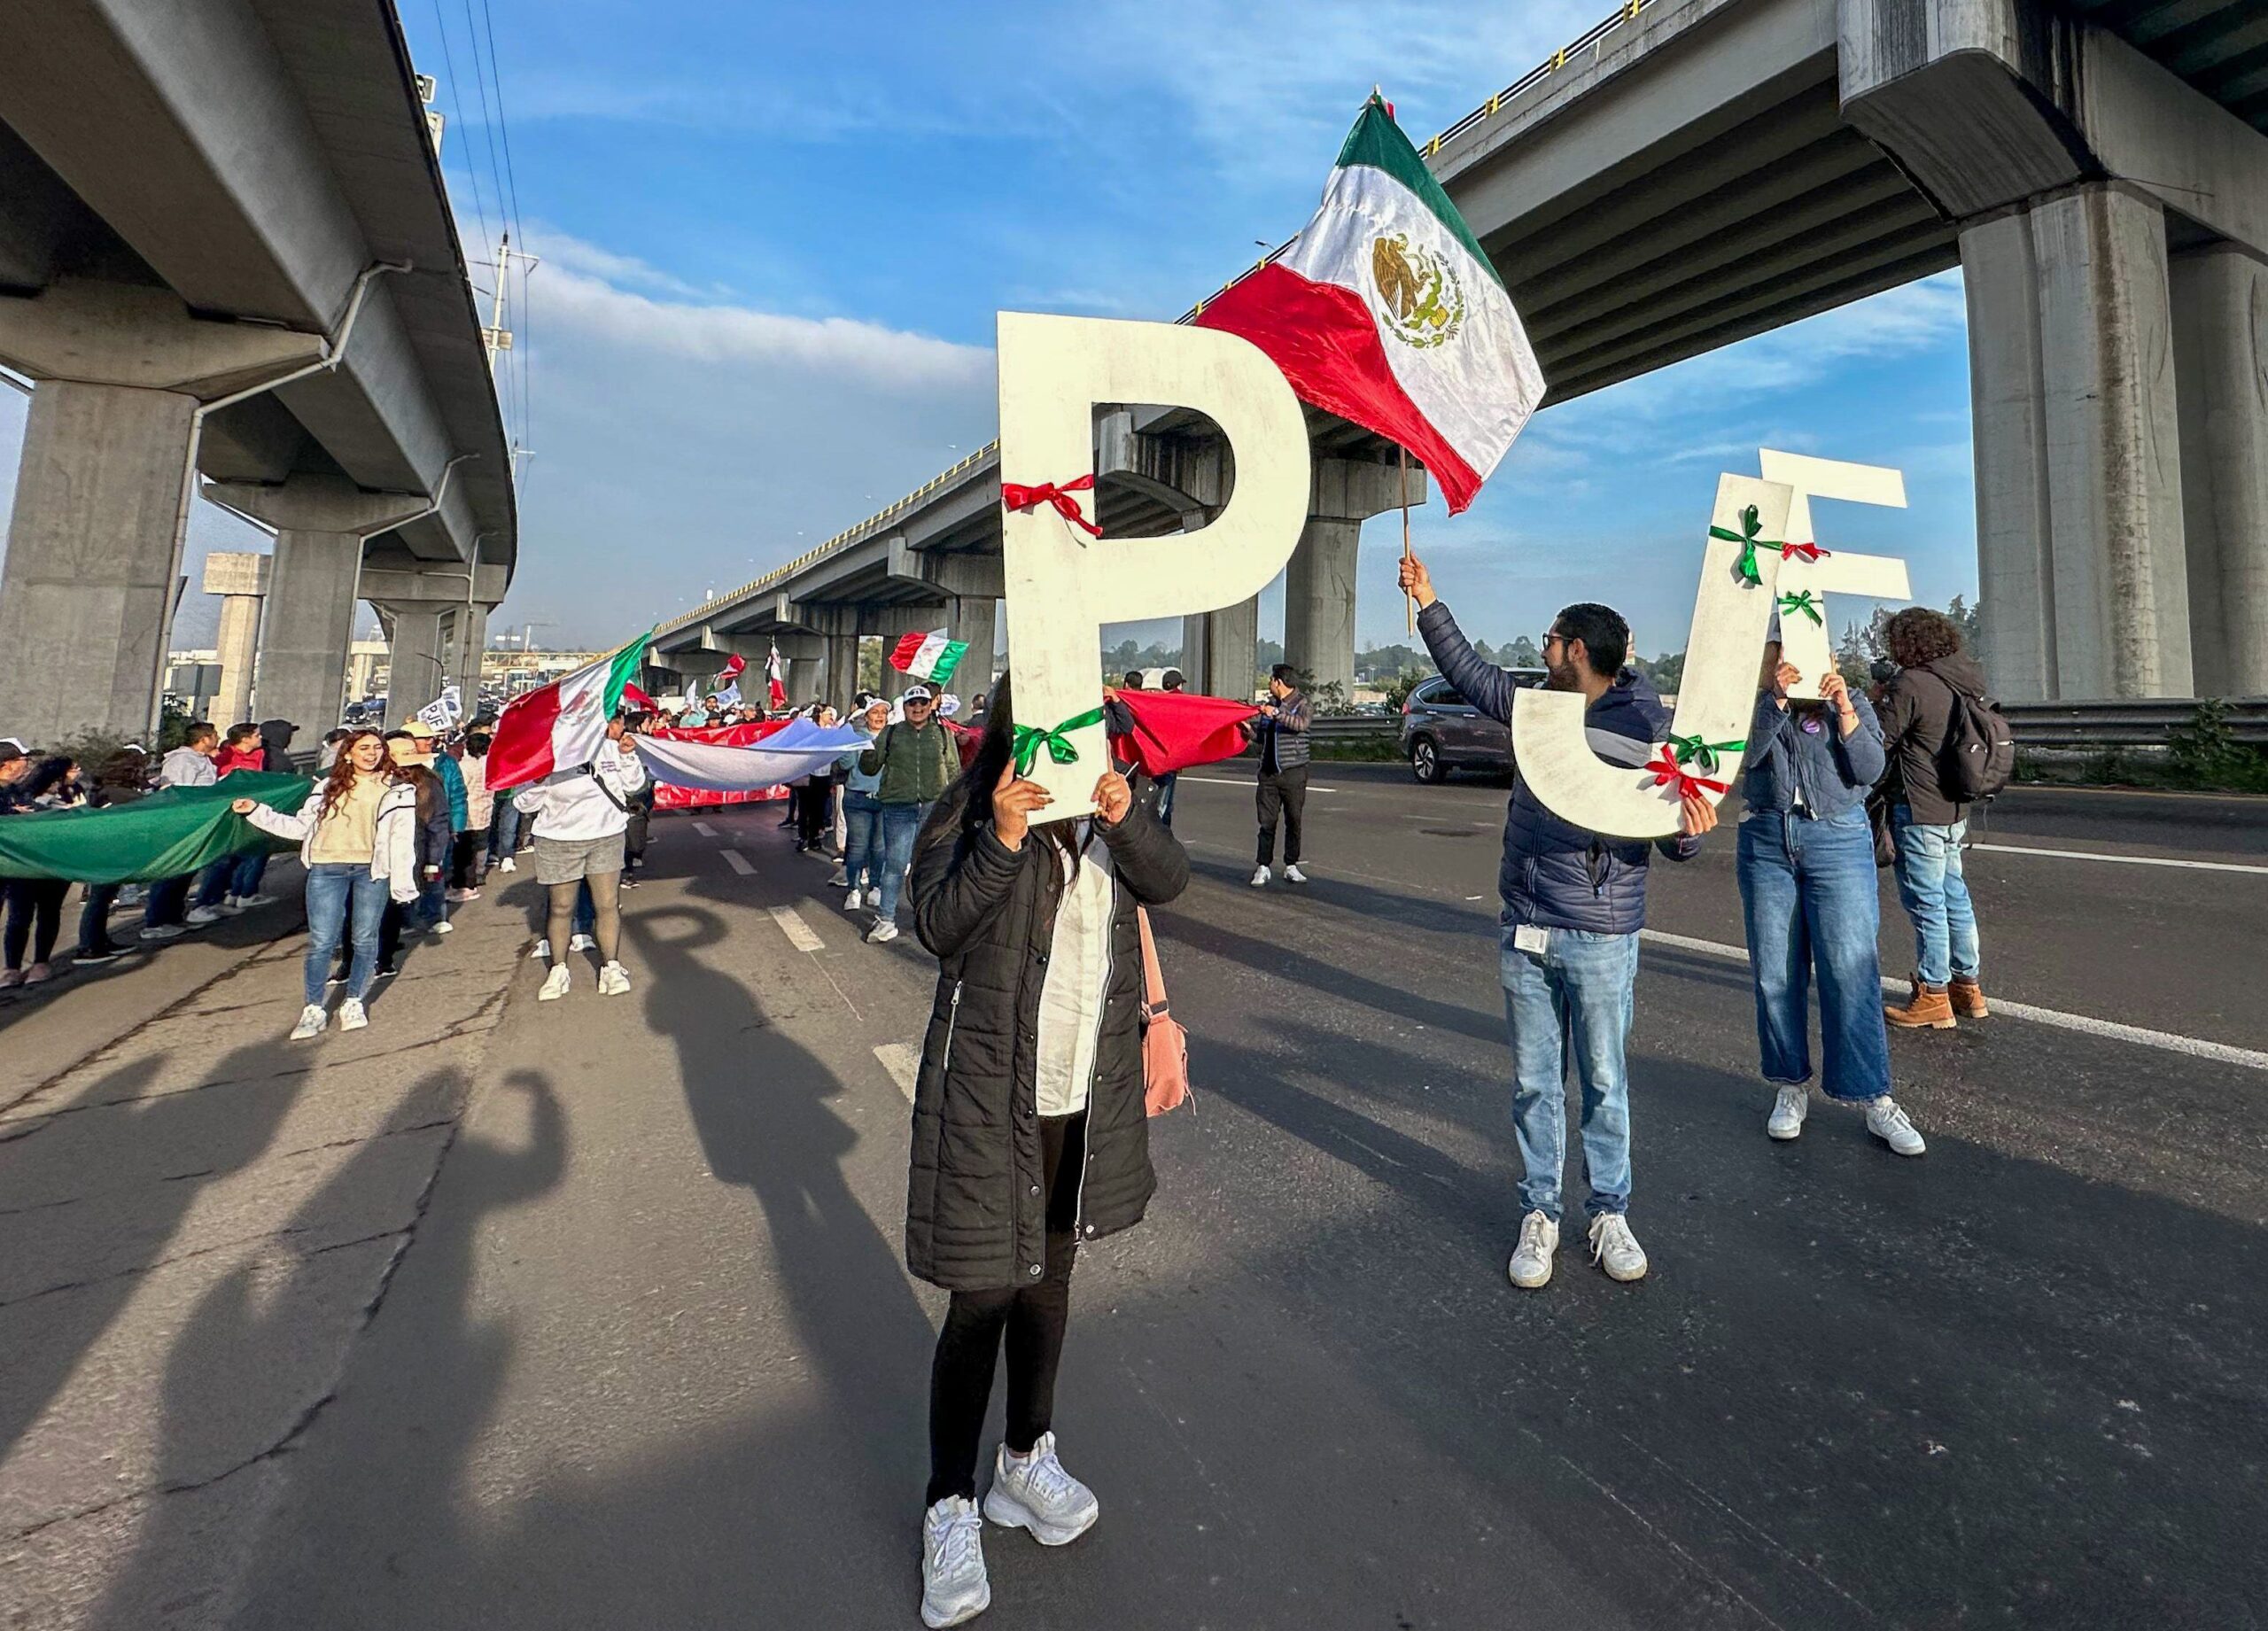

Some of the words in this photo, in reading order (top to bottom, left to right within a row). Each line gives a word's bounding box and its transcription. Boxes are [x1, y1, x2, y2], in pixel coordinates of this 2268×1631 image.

[425, 704, 445, 726] PJF
[997, 311, 1311, 826] P
[1512, 472, 1793, 838] J
[1759, 447, 1911, 700] F
